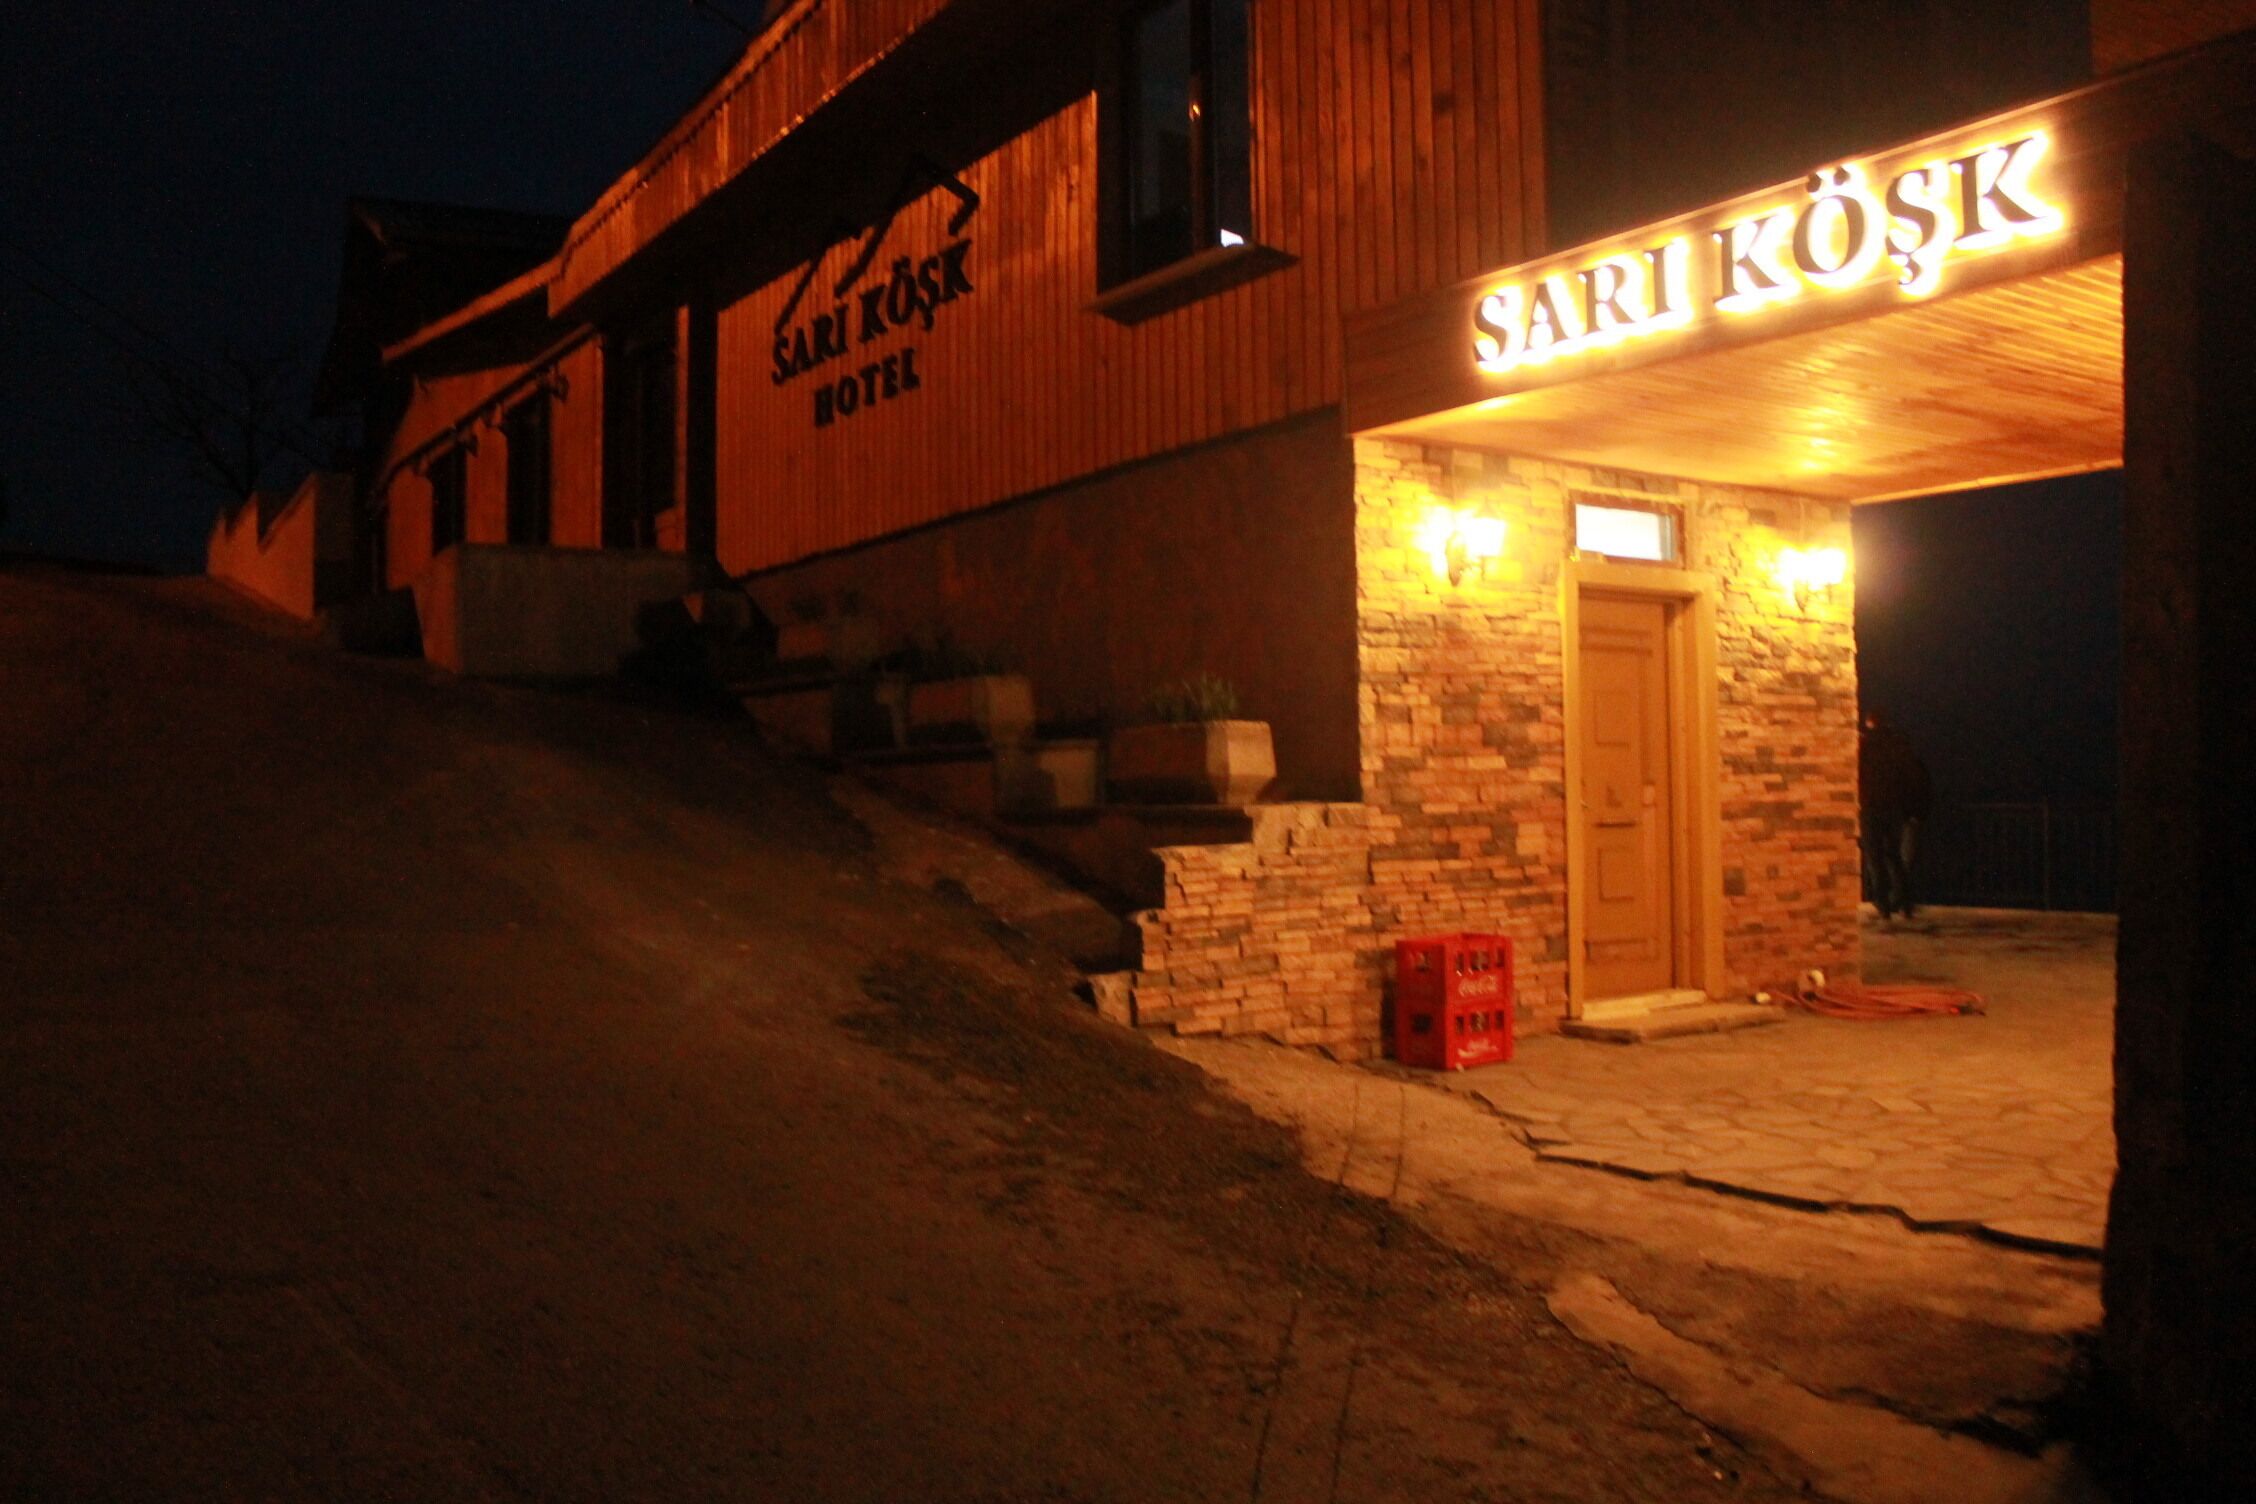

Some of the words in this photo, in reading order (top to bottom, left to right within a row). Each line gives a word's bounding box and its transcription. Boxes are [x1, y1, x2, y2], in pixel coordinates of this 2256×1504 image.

[772, 304, 848, 385] SARI
[858, 239, 973, 343] KÖŞK
[1473, 238, 1680, 366] SARI
[1712, 134, 2052, 302] KÖŞK
[814, 348, 920, 427] HOTEL
